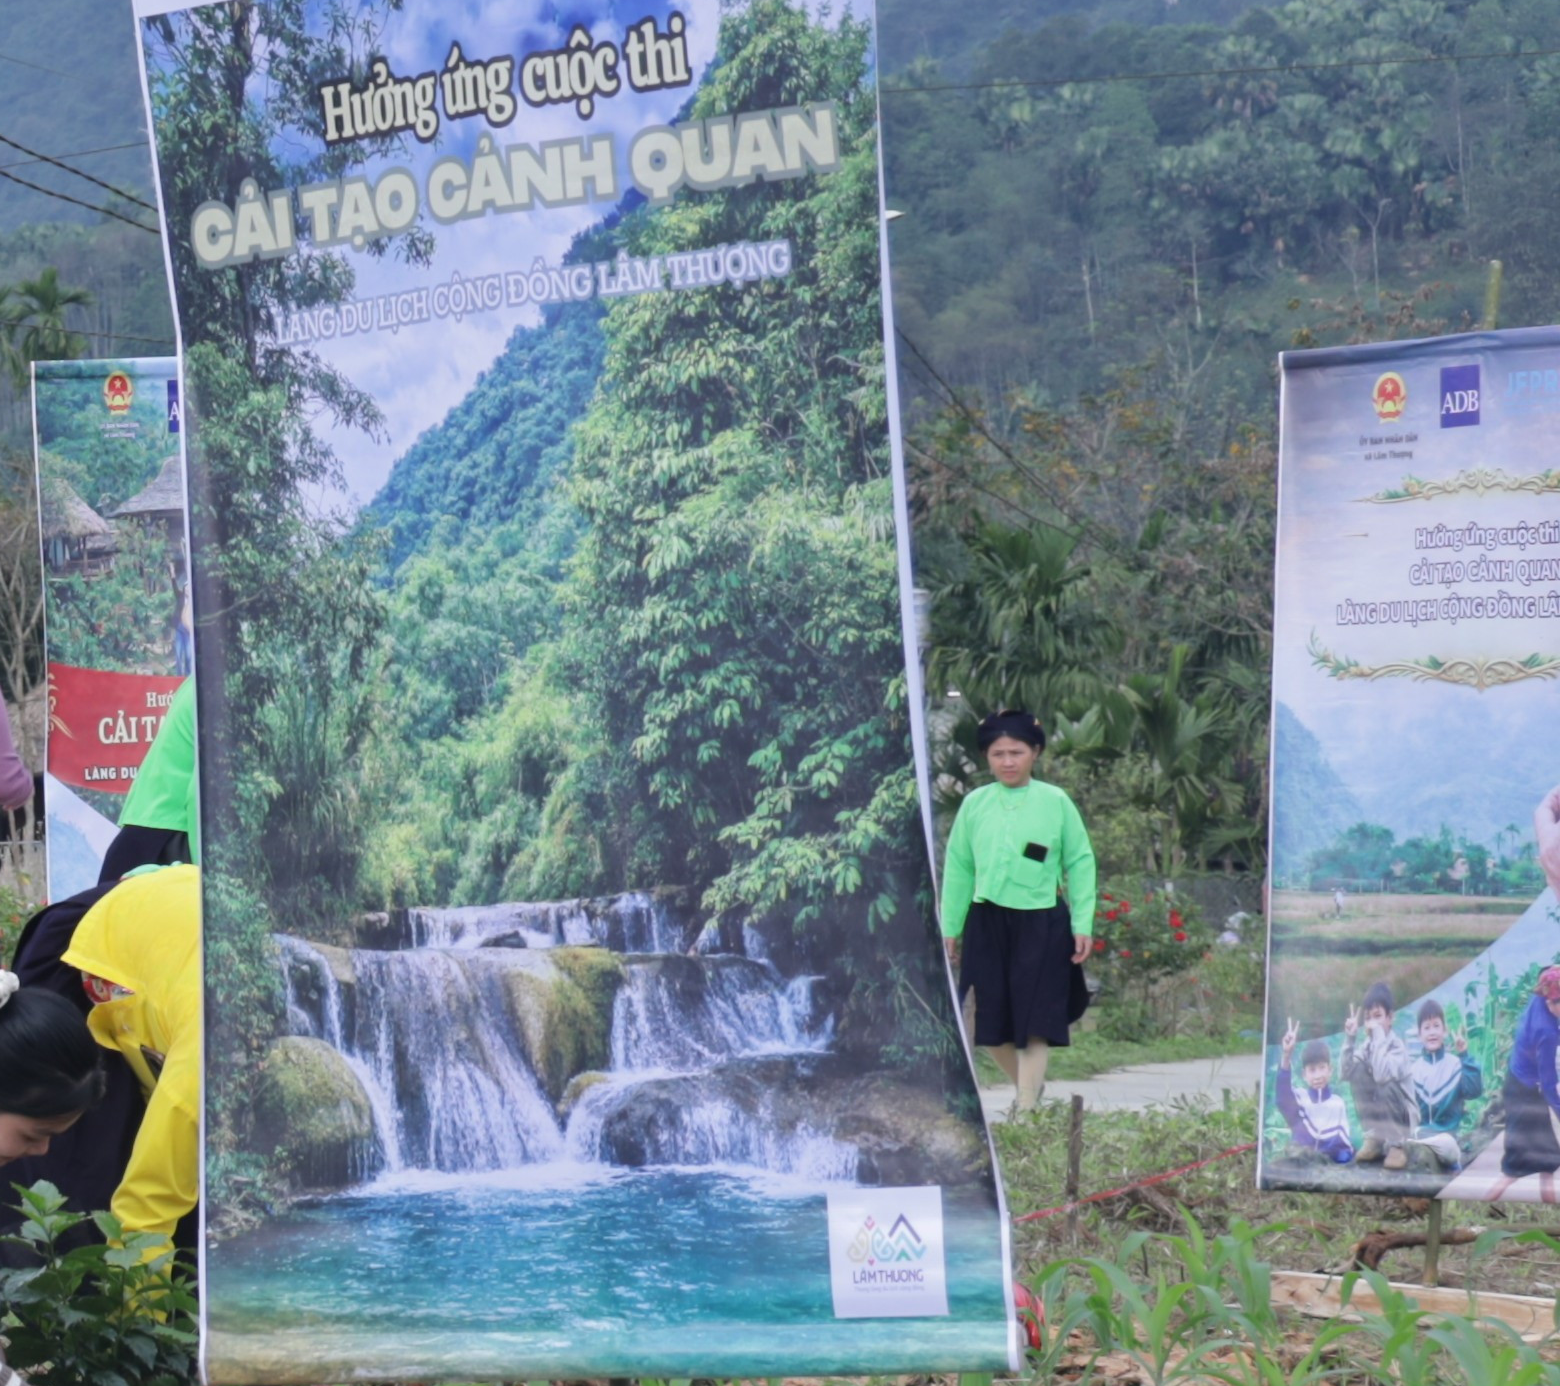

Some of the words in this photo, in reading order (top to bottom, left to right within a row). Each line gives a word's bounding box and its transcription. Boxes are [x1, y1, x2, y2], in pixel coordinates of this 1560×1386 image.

[320, 61, 437, 142] Hưởng
[442, 45, 514, 124] ứng
[522, 27, 618, 116] cuộc
[624, 15, 690, 89] thi
[192, 178, 292, 264] CẢI
[303, 171, 416, 251] TẠO
[427, 131, 614, 220] CẢNH
[630, 108, 838, 199] QUAN
[340, 299, 373, 334] DU
[378, 288, 429, 335] LỊCH
[434, 272, 501, 322] CỘNG
[507, 256, 593, 305] ĐỒNG
[597, 249, 662, 296] LÂM
[667, 241, 790, 289] THƯỢNG
[1504, 369, 1559, 398] JFPR
[1441, 390, 1479, 414] ADB
[1415, 523, 1464, 551] Hưởng
[1465, 521, 1497, 550] ứng
[1498, 521, 1537, 550] cuộc
[1538, 520, 1560, 545] thi
[1409, 557, 1434, 586] CẢI
[1435, 561, 1465, 589] TẠO
[1466, 554, 1513, 582] CẢNH
[1516, 558, 1560, 586] QUAN
[1337, 598, 1377, 625] LÀNG
[1379, 601, 1402, 623] DU
[1403, 598, 1438, 627] LỊCH
[1439, 592, 1483, 625] CỘNG
[1485, 589, 1536, 618] ĐỒNG
[1538, 590, 1560, 618] LÂ
[98, 710, 138, 744] CẢI
[84, 766, 117, 781] LÀNG
[120, 767, 138, 780] DU
